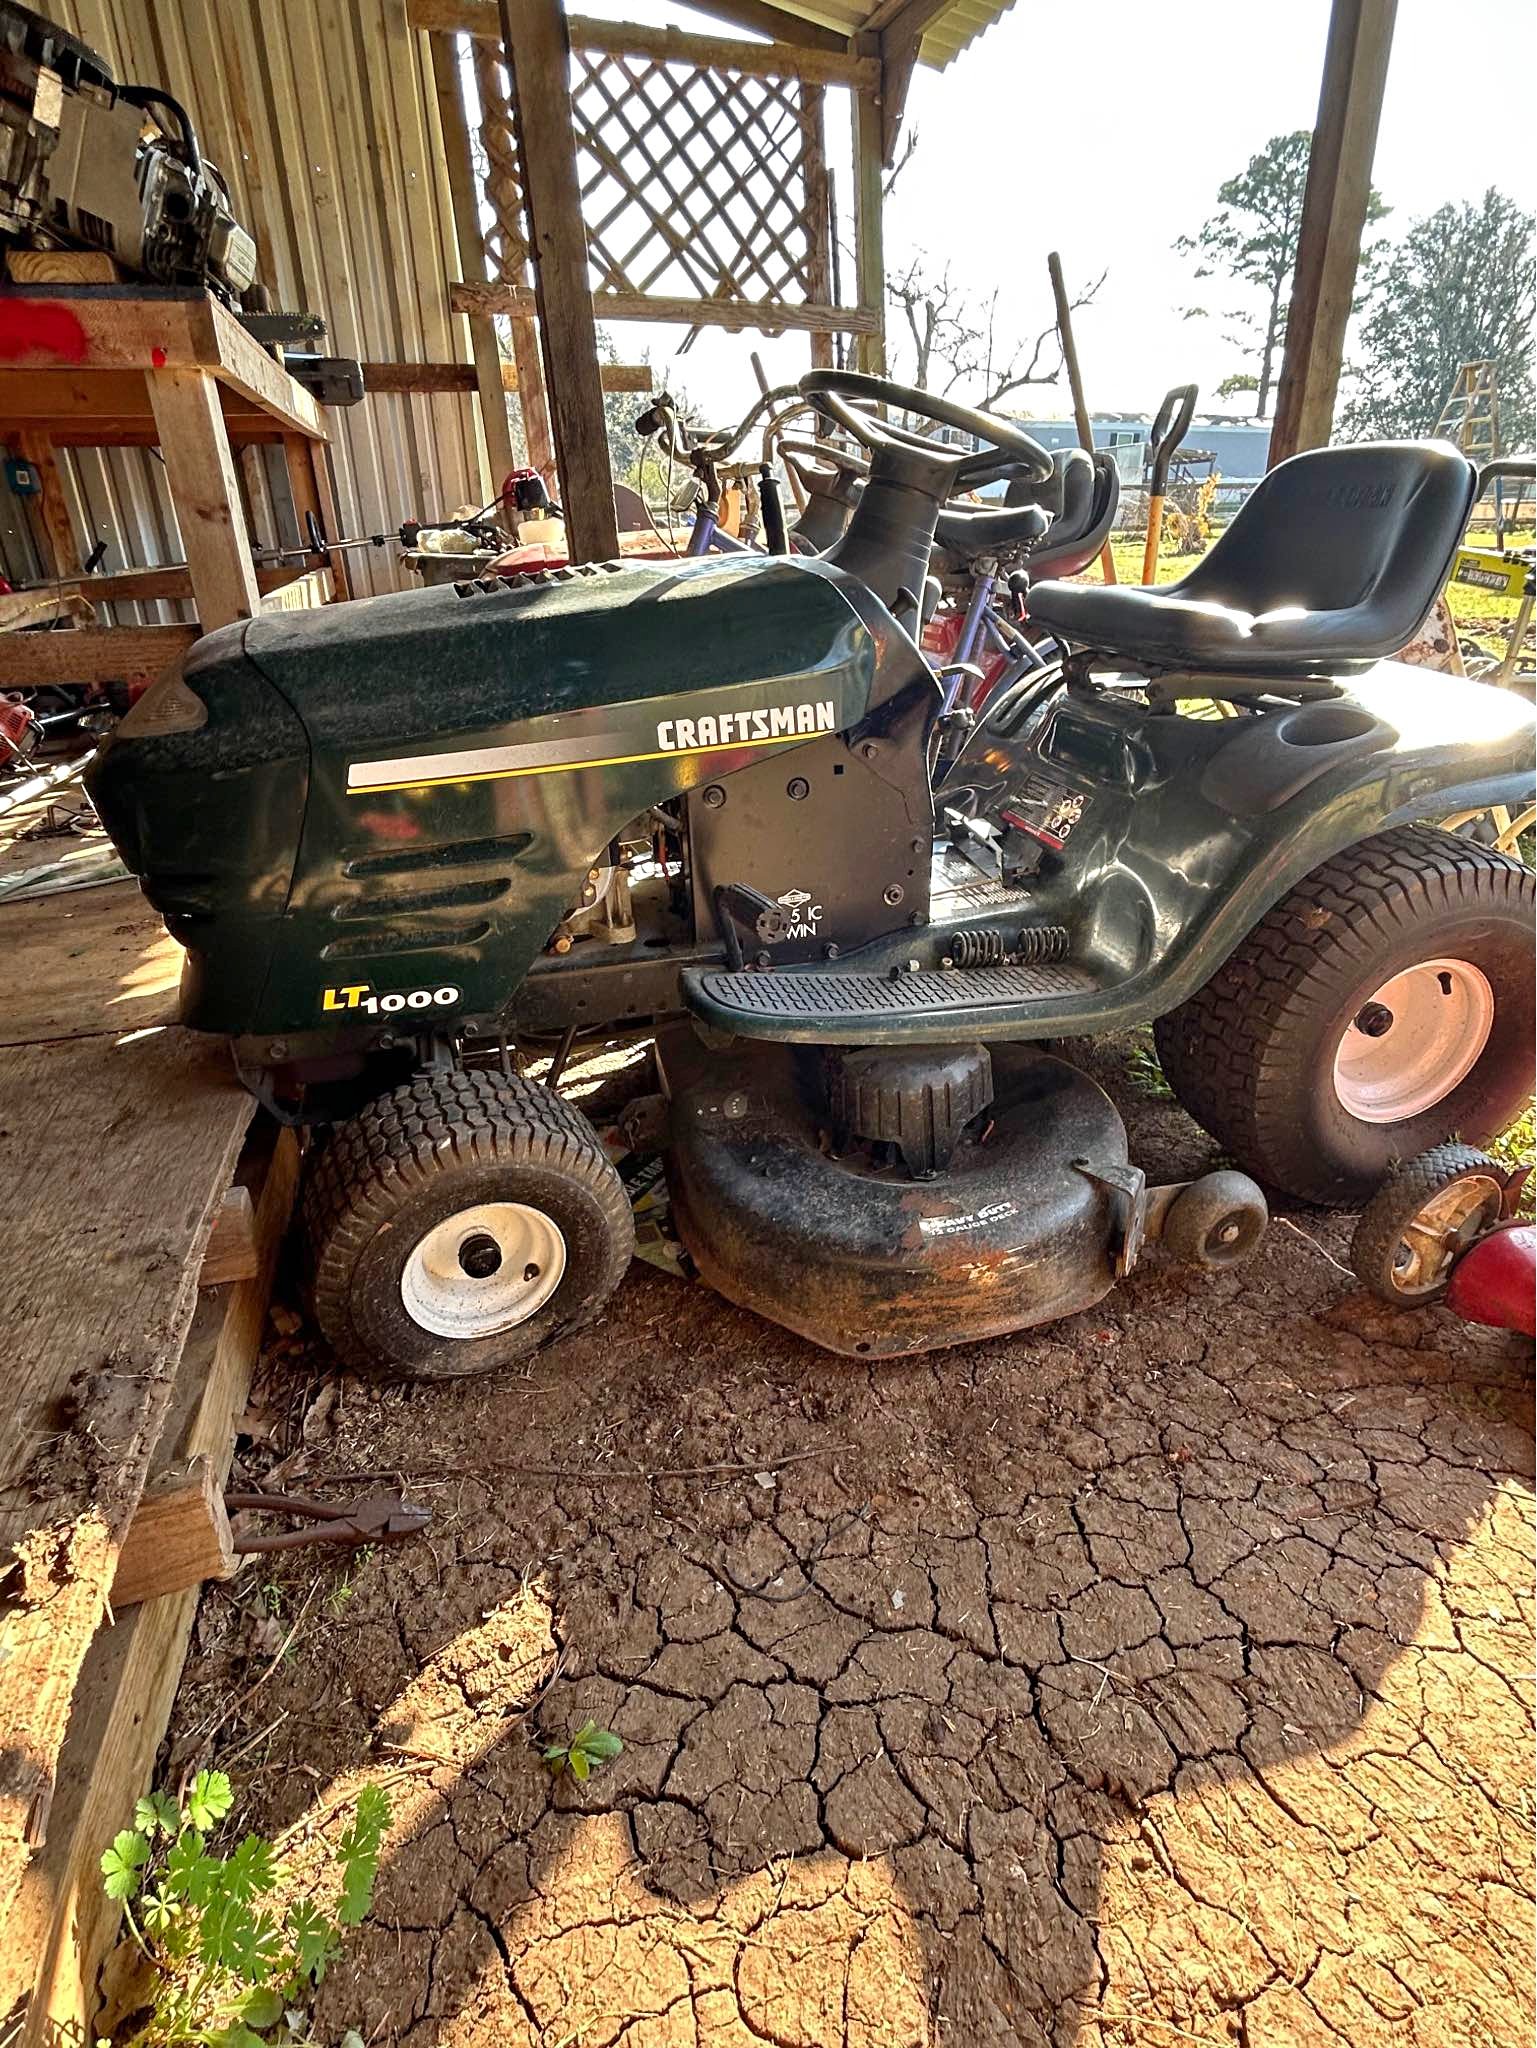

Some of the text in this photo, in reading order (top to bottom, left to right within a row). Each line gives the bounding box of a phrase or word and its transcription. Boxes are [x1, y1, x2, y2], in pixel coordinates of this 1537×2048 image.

[657, 701, 835, 751] CRAFTSMAN
[808, 905, 823, 921] IC
[946, 1219, 988, 1233] GAUGE
[989, 1208, 1019, 1223] DECK
